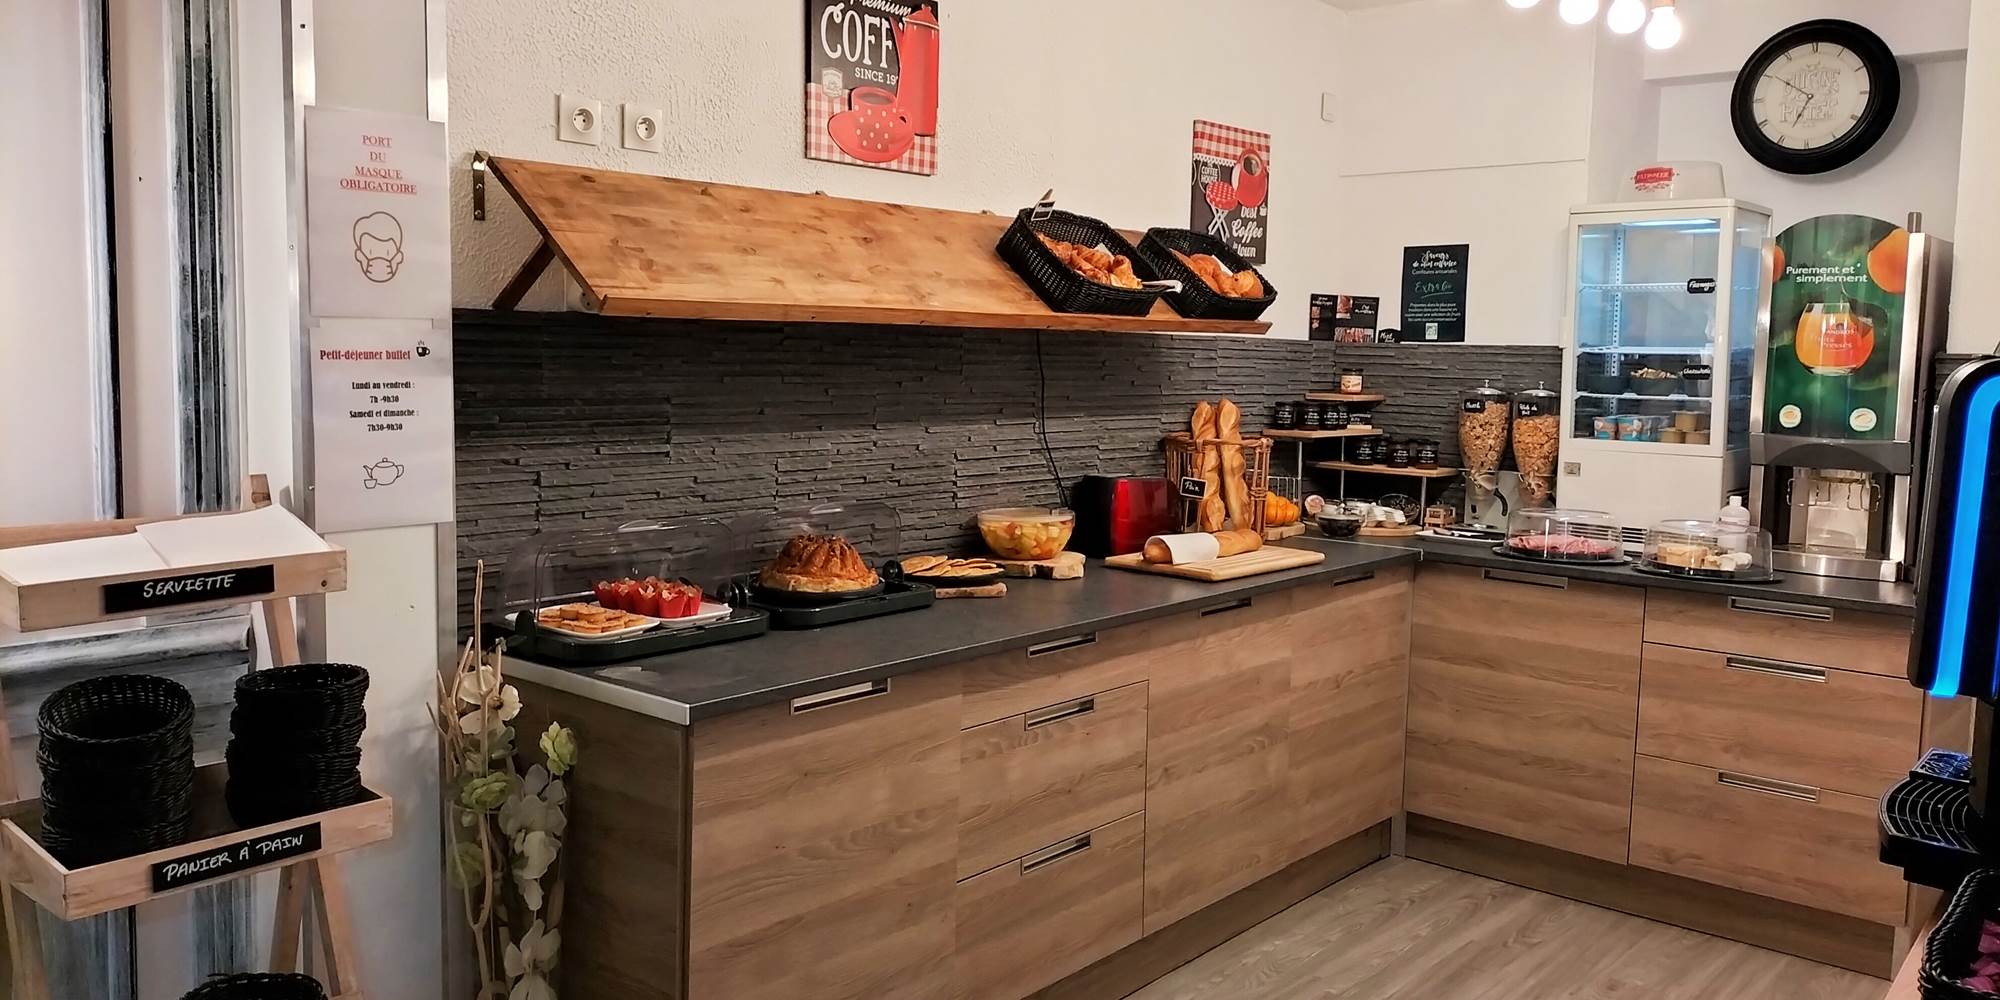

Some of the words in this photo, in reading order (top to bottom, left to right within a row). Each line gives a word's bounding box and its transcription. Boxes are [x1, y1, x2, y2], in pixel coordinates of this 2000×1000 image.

[850, 0, 911, 16] remium
[855, 67, 884, 83] SINCE
[886, 74, 899, 86] 19
[362, 135, 393, 148] PORT
[370, 152, 386, 163] DU
[355, 166, 403, 180] MASQUE
[340, 179, 417, 195] OBLIGATOIRE
[1231, 218, 1263, 243] Coffee
[1786, 266, 1840, 275] Purement
[1842, 266, 1854, 274] et
[1796, 273, 1868, 284] simplement
[352, 381, 371, 390] Lundi
[382, 381, 411, 389] vendredi
[369, 395, 379, 403] 7h
[349, 410, 374, 418] Samedi
[383, 409, 415, 417] dimanche
[367, 423, 403, 432] 7h30-9h30
[143, 574, 237, 598] SERVIETTE
[162, 852, 232, 882] PANIER
[239, 840, 250, 860] À
[256, 834, 304, 855] PAIN
